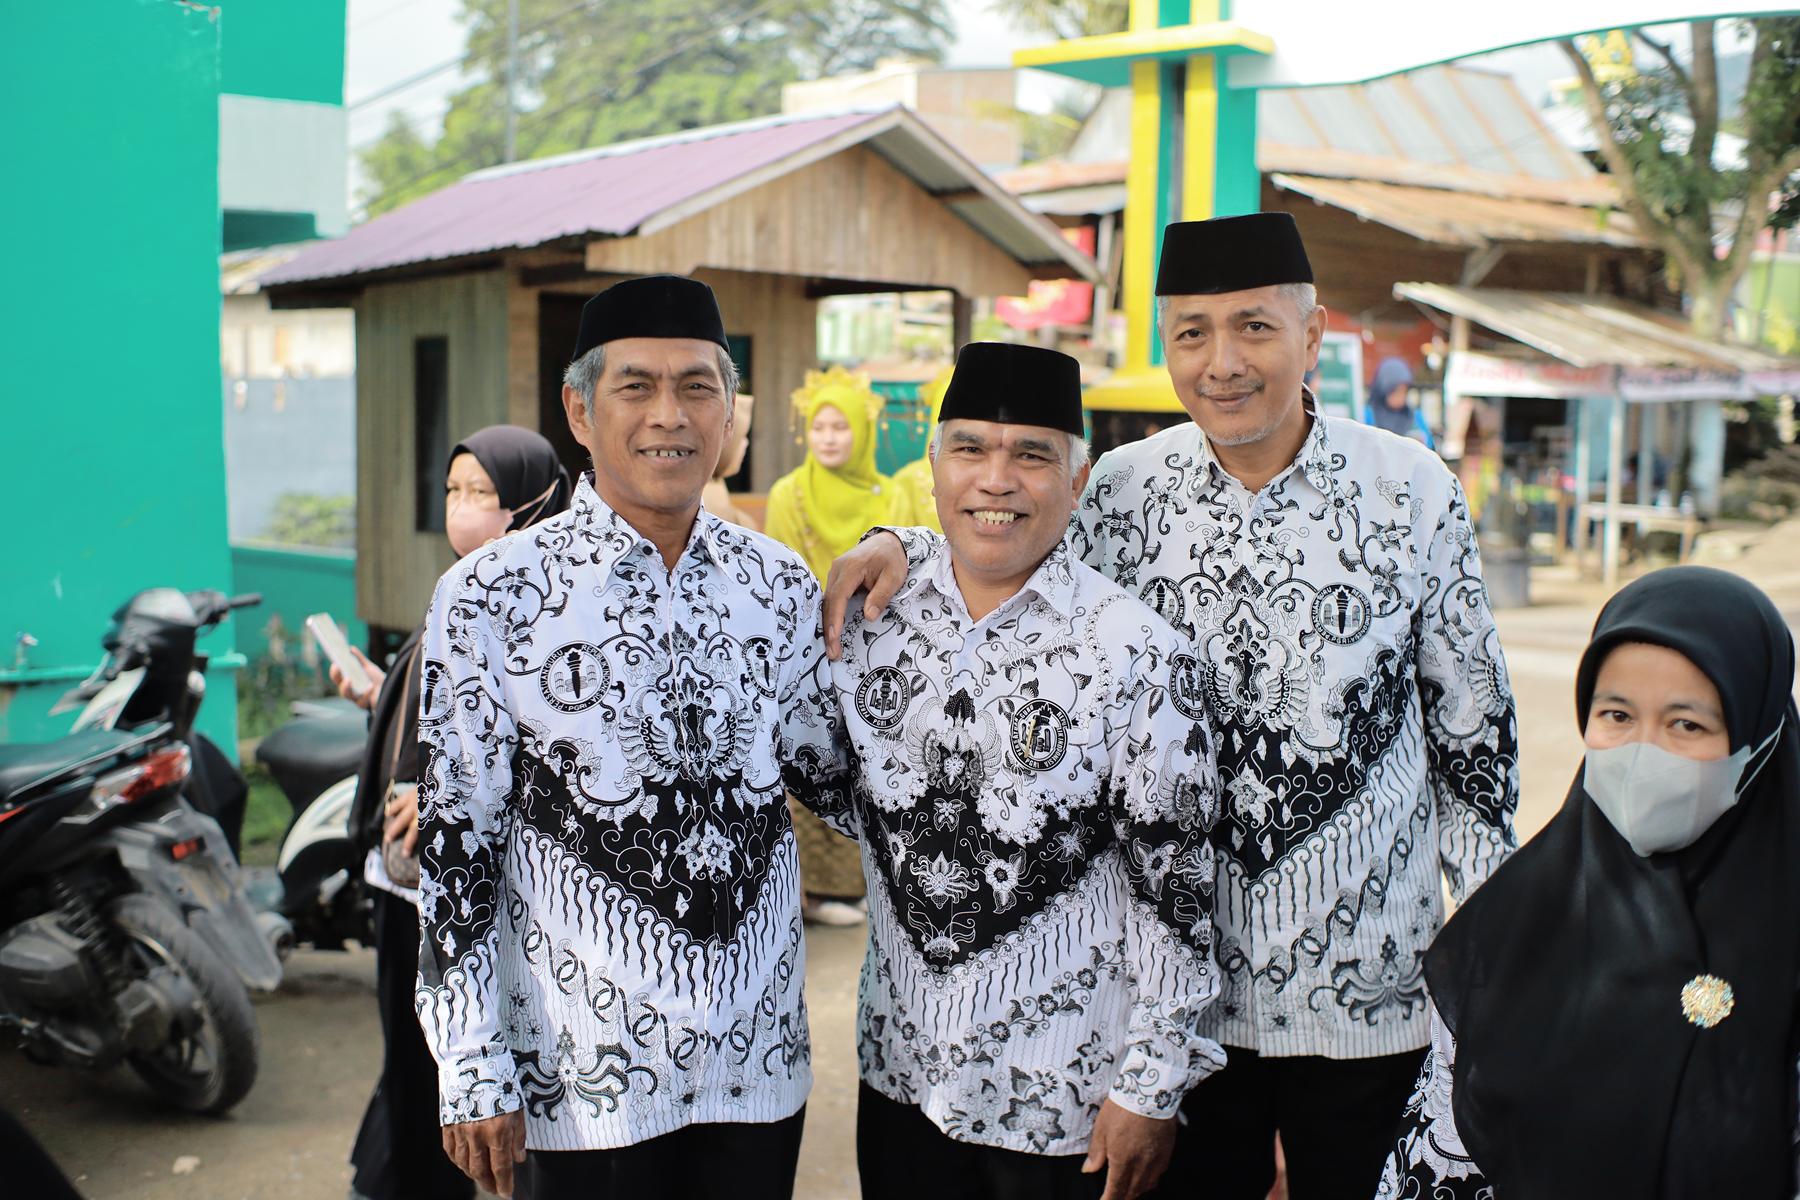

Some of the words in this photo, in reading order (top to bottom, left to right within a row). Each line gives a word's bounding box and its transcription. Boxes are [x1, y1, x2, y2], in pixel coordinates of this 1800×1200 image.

[544, 650, 564, 670] GURU
[581, 644, 609, 669] REPUBLIK
[540, 668, 564, 710] PERSATUAN
[590, 667, 611, 703] INDONESIA
[568, 702, 588, 712] PGRI
